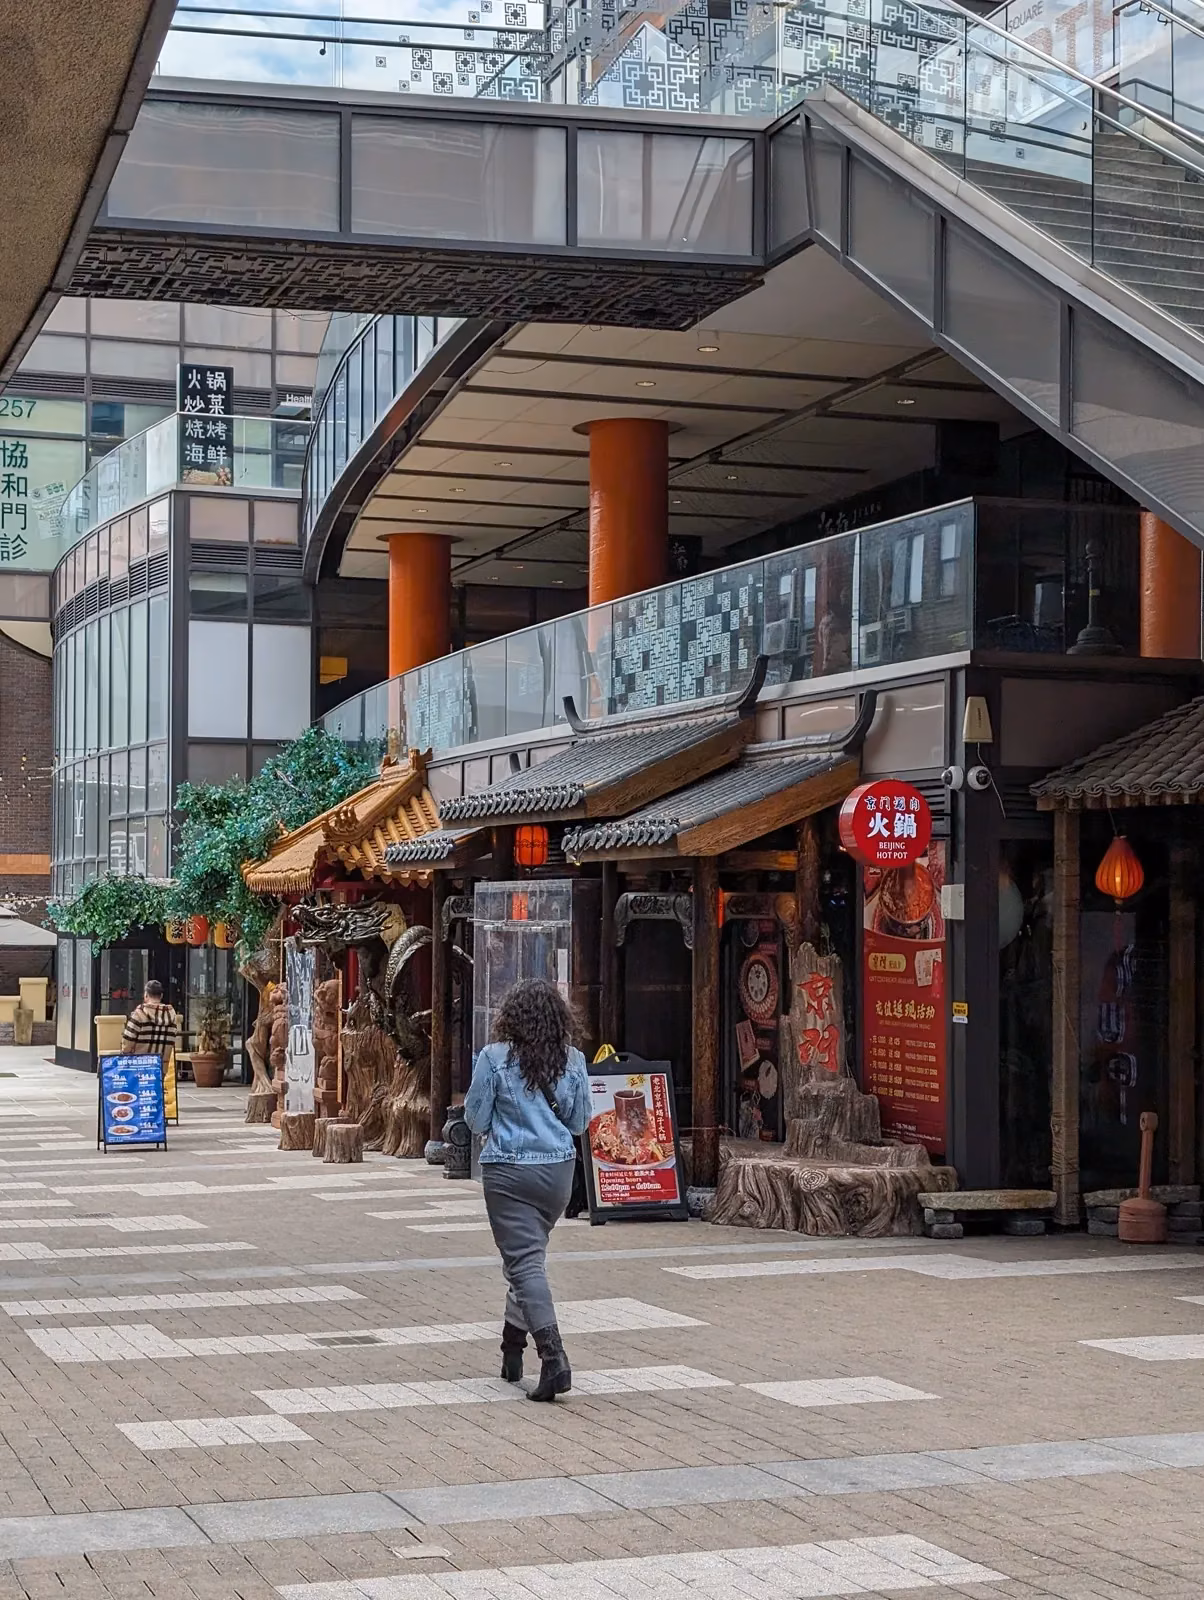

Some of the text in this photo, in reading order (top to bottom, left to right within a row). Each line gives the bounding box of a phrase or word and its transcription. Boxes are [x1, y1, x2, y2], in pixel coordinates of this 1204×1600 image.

[1007, 0, 1045, 33] SQUARE
[187, 368, 227, 392] 火锅
[184, 393, 226, 415] 炒菜
[185, 418, 228, 441] 烧烤
[184, 442, 228, 465] 海鲜
[0, 440, 29, 562] 協和門診
[866, 812, 918, 839] 火鍋
[876, 851, 909, 860] HOT POT
[878, 841, 906, 851] BEIJING
